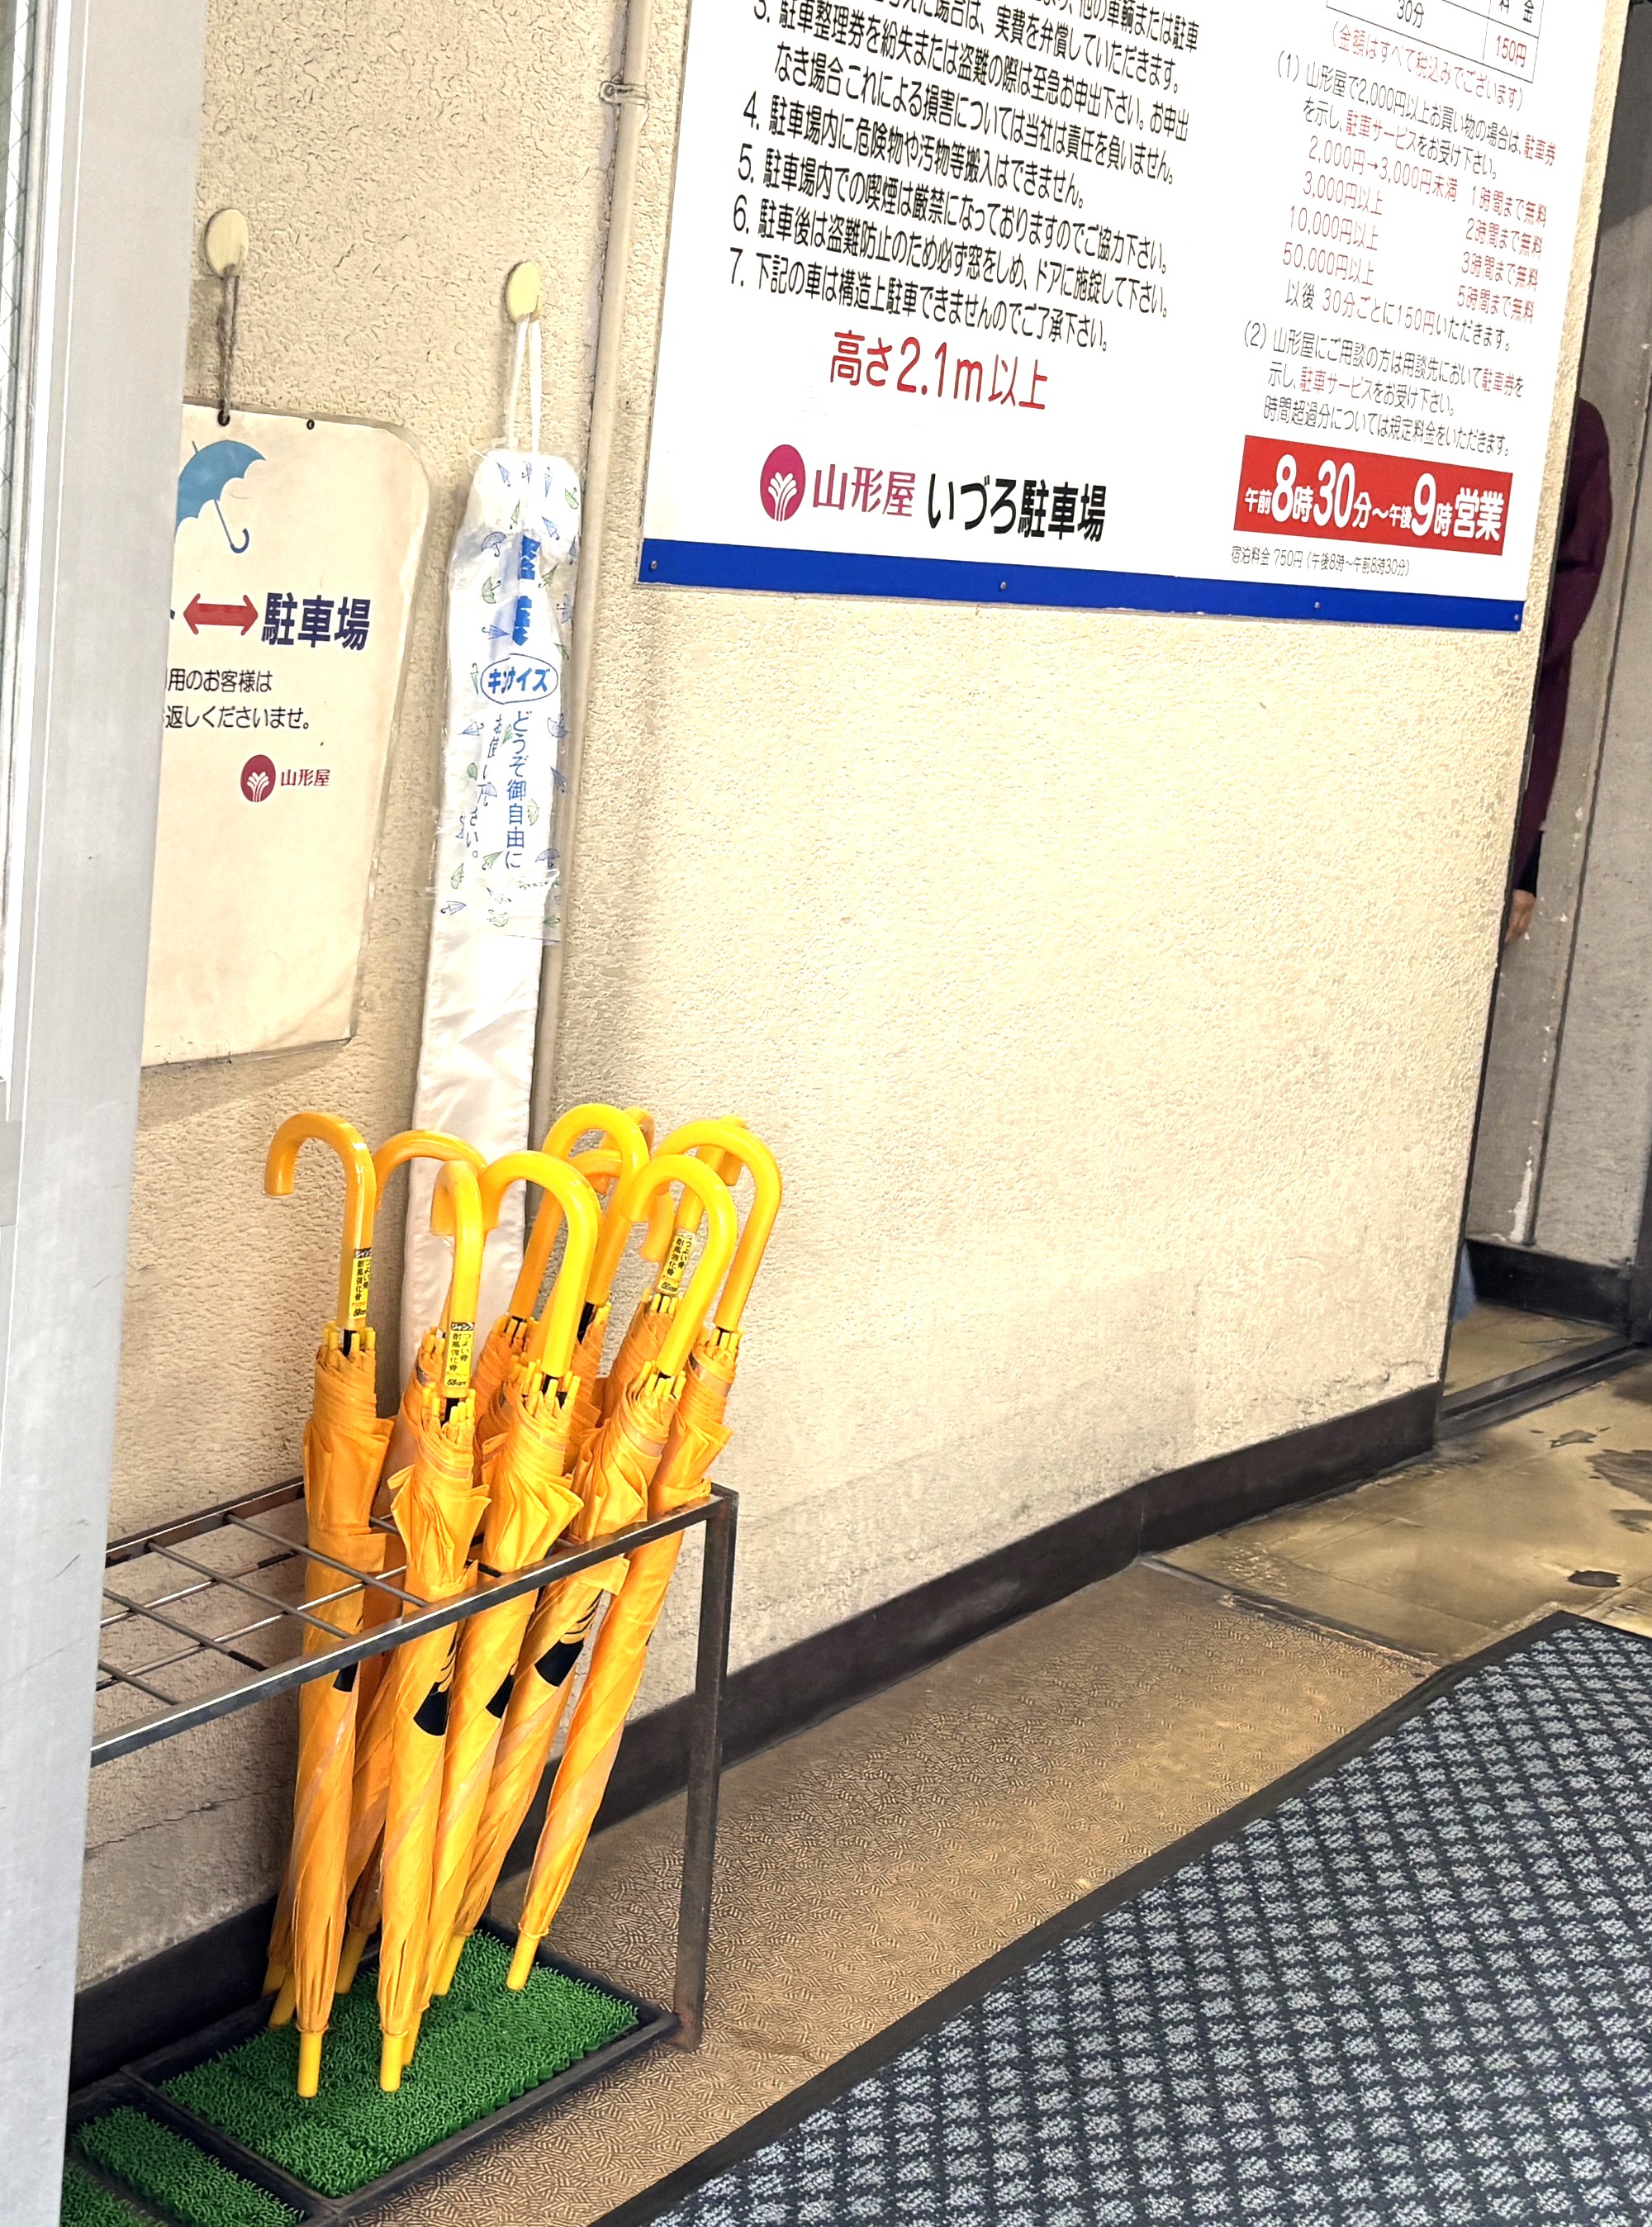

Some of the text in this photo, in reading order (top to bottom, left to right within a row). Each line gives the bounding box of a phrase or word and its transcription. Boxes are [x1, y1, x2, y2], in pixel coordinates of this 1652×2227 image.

[1397, 0, 1424, 28] 30分
[1497, 35, 1526, 68] 150円
[743, 91, 1083, 208] 4. 駐車場内に危険物や汚物等搬入はできません。
[775, 41, 1173, 184] なき場合これによる損害については当社は責任を負いません。
[733, 195, 749, 234] 6.
[738, 143, 1165, 273] 5. 駐車場内での喫煙は厳禁になっておりますのでご協力下さい。
[1303, 171, 1543, 259] 3,000円以上 2時間まで無料
[1284, 242, 1535, 324] 50,000円以上 5時間まで無料
[1290, 205, 1539, 291] 10,000円以上 3時間まで無料
[730, 247, 1107, 351] 7. 下記の車は構造上駐車できませんのでご了承下さい。
[830, 330, 1047, 410] 高さ2.1m以上
[1264, 396, 1508, 456] 時間超過分については規定料金をいただきます。
[813, 463, 1106, 542] 山形屋 いづろ駐車場
[1275, 549, 1303, 568] 750円
[261, 592, 370, 650] 駐車場
[163, 705, 309, 729] 返しくださいませ。
[166, 668, 273, 693] 用のお客様は
[281, 769, 330, 786] 山形屋
[505, 710, 532, 869] どうぞ御自由に
